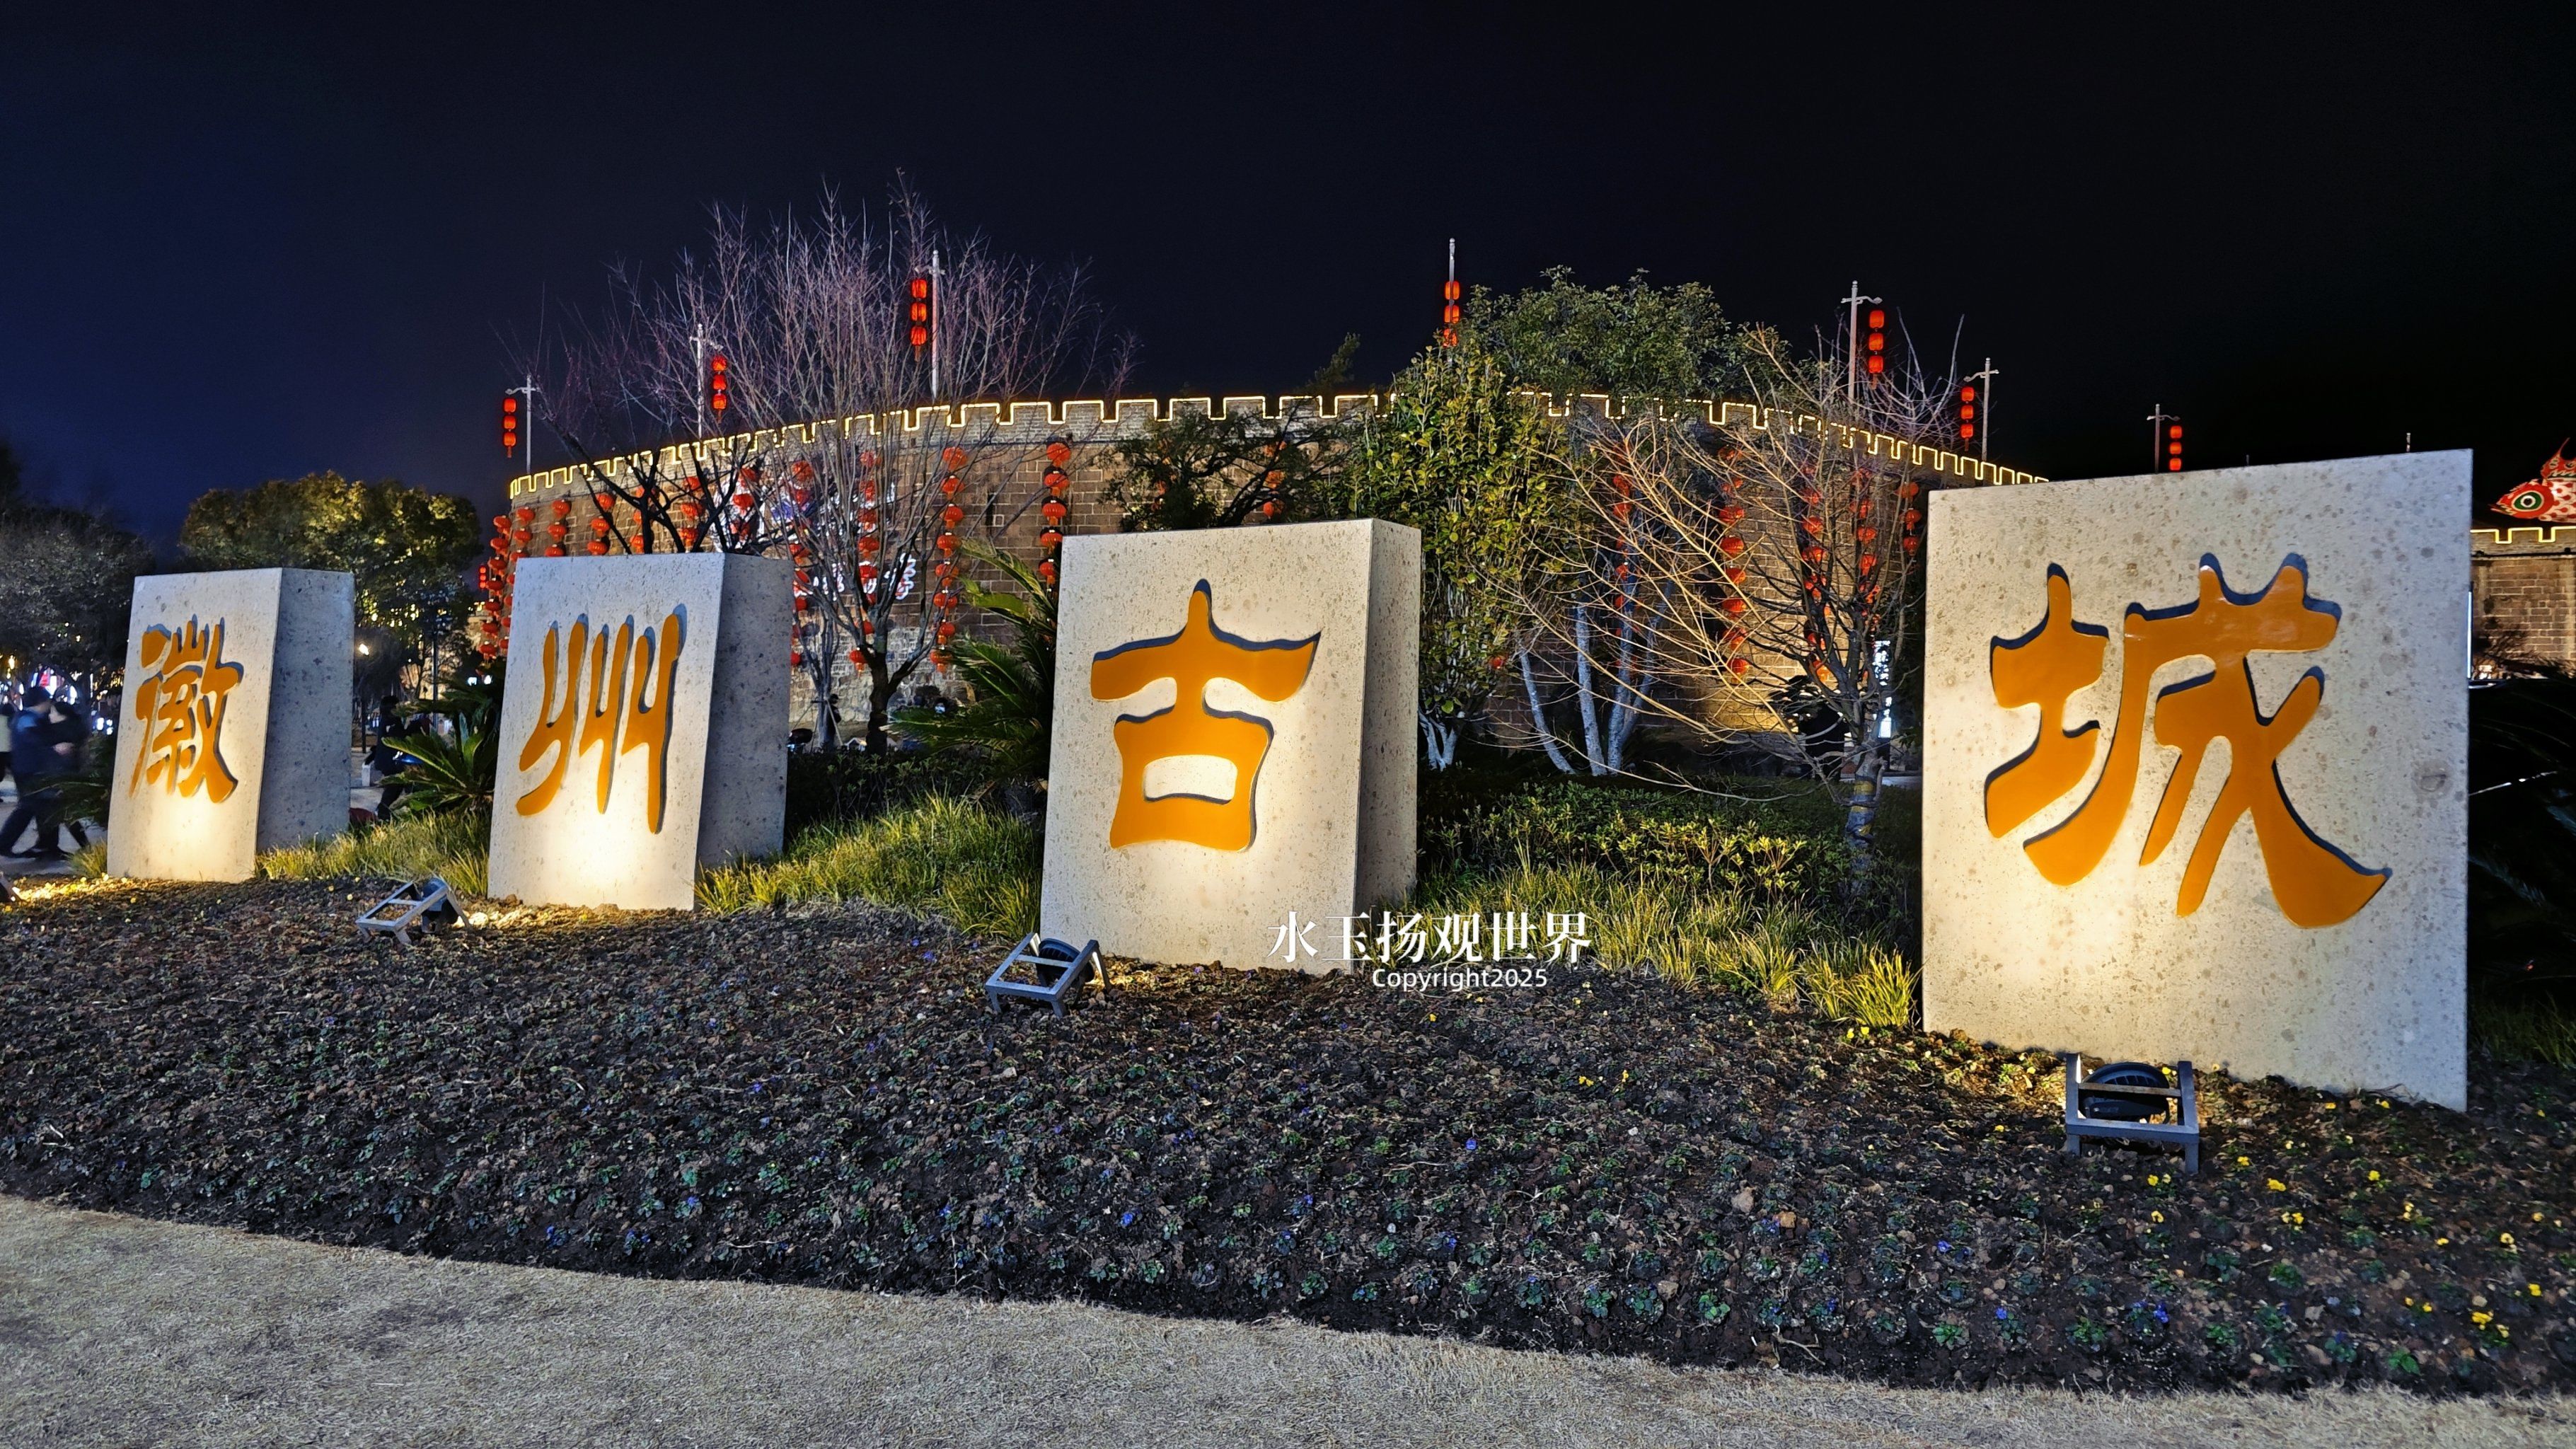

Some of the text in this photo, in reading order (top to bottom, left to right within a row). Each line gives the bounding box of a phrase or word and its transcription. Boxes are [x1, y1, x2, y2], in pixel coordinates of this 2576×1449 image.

[515, 604, 687, 835] 州
[1090, 579, 1321, 853] 古
[1984, 553, 2393, 928] 城
